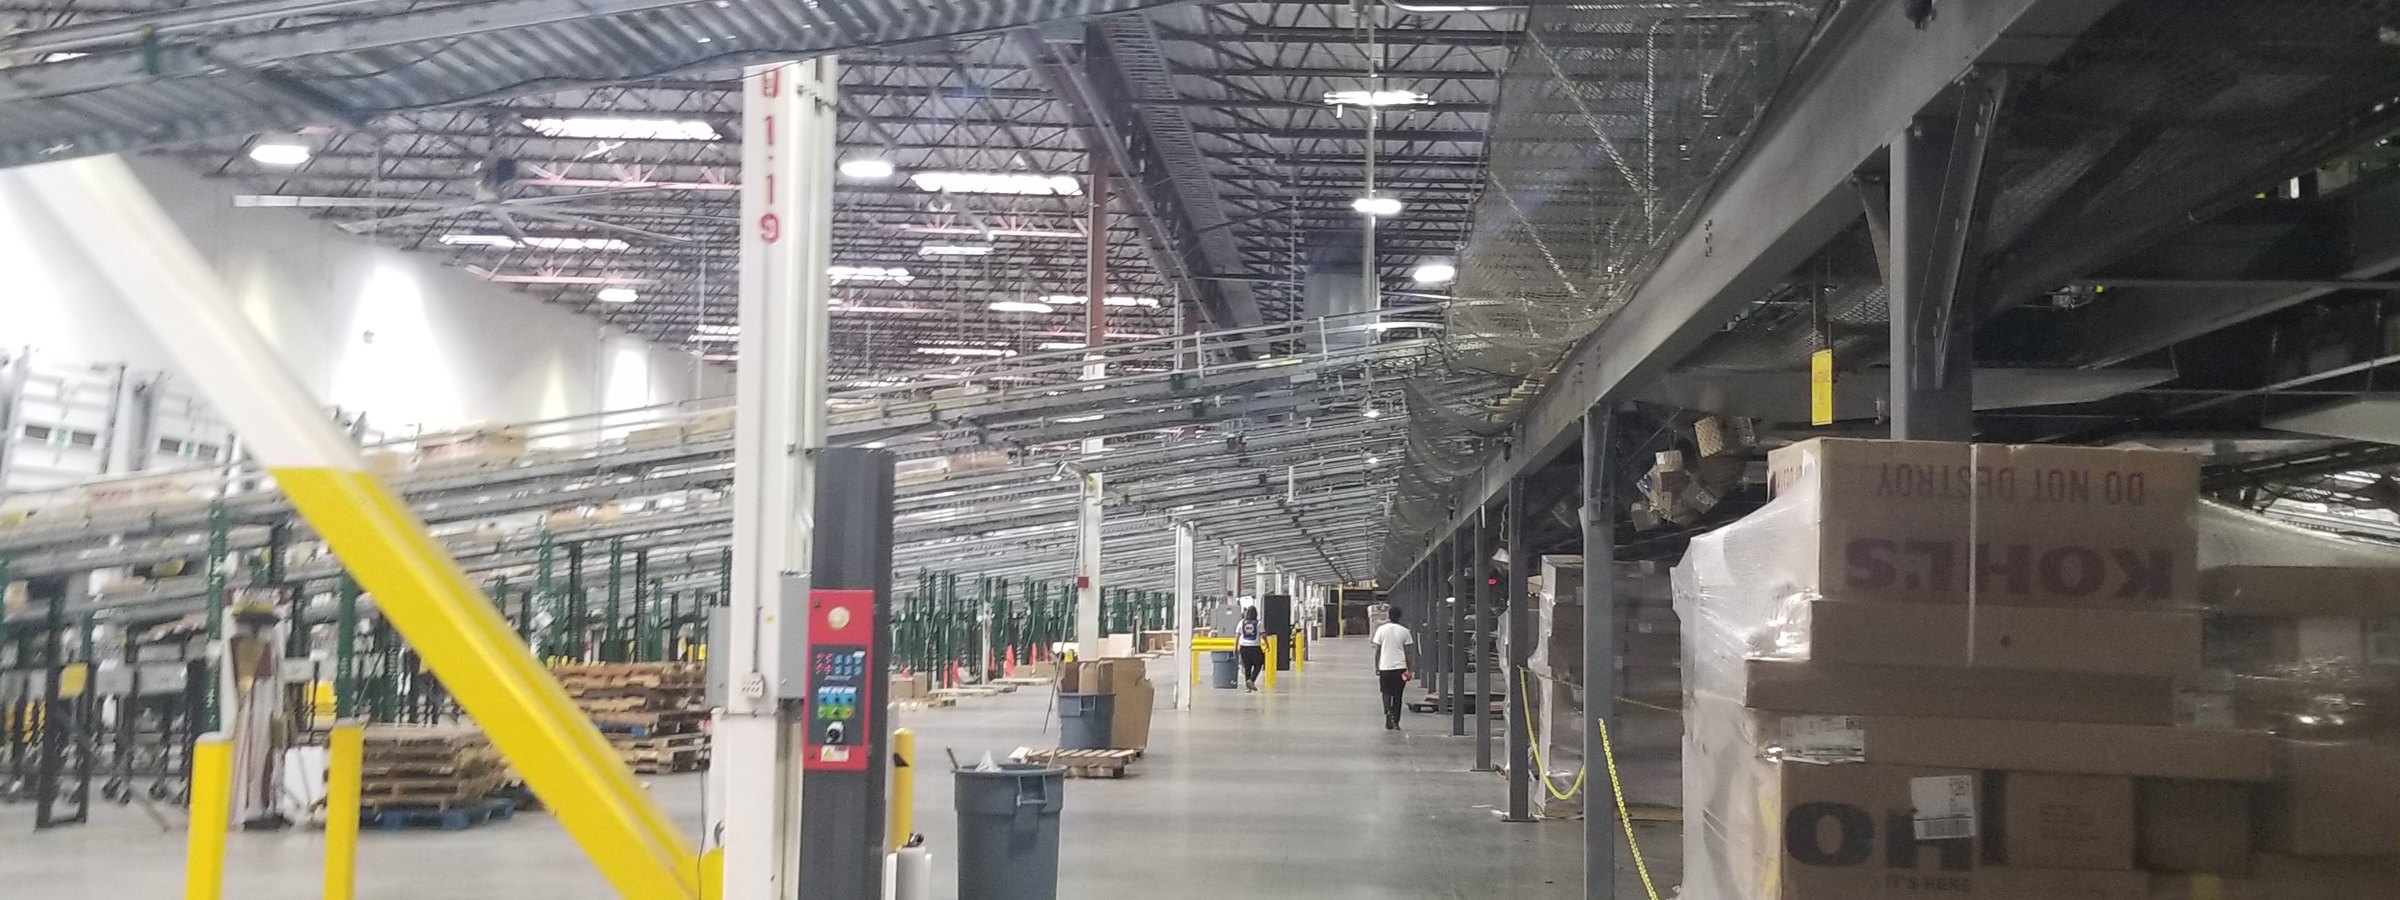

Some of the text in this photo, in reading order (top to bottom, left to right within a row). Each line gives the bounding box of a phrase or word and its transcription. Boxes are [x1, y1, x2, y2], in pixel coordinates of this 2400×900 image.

[1877, 463, 2145, 506] DO NOT DESTROY
[1844, 538, 2175, 600] KOHL'S
